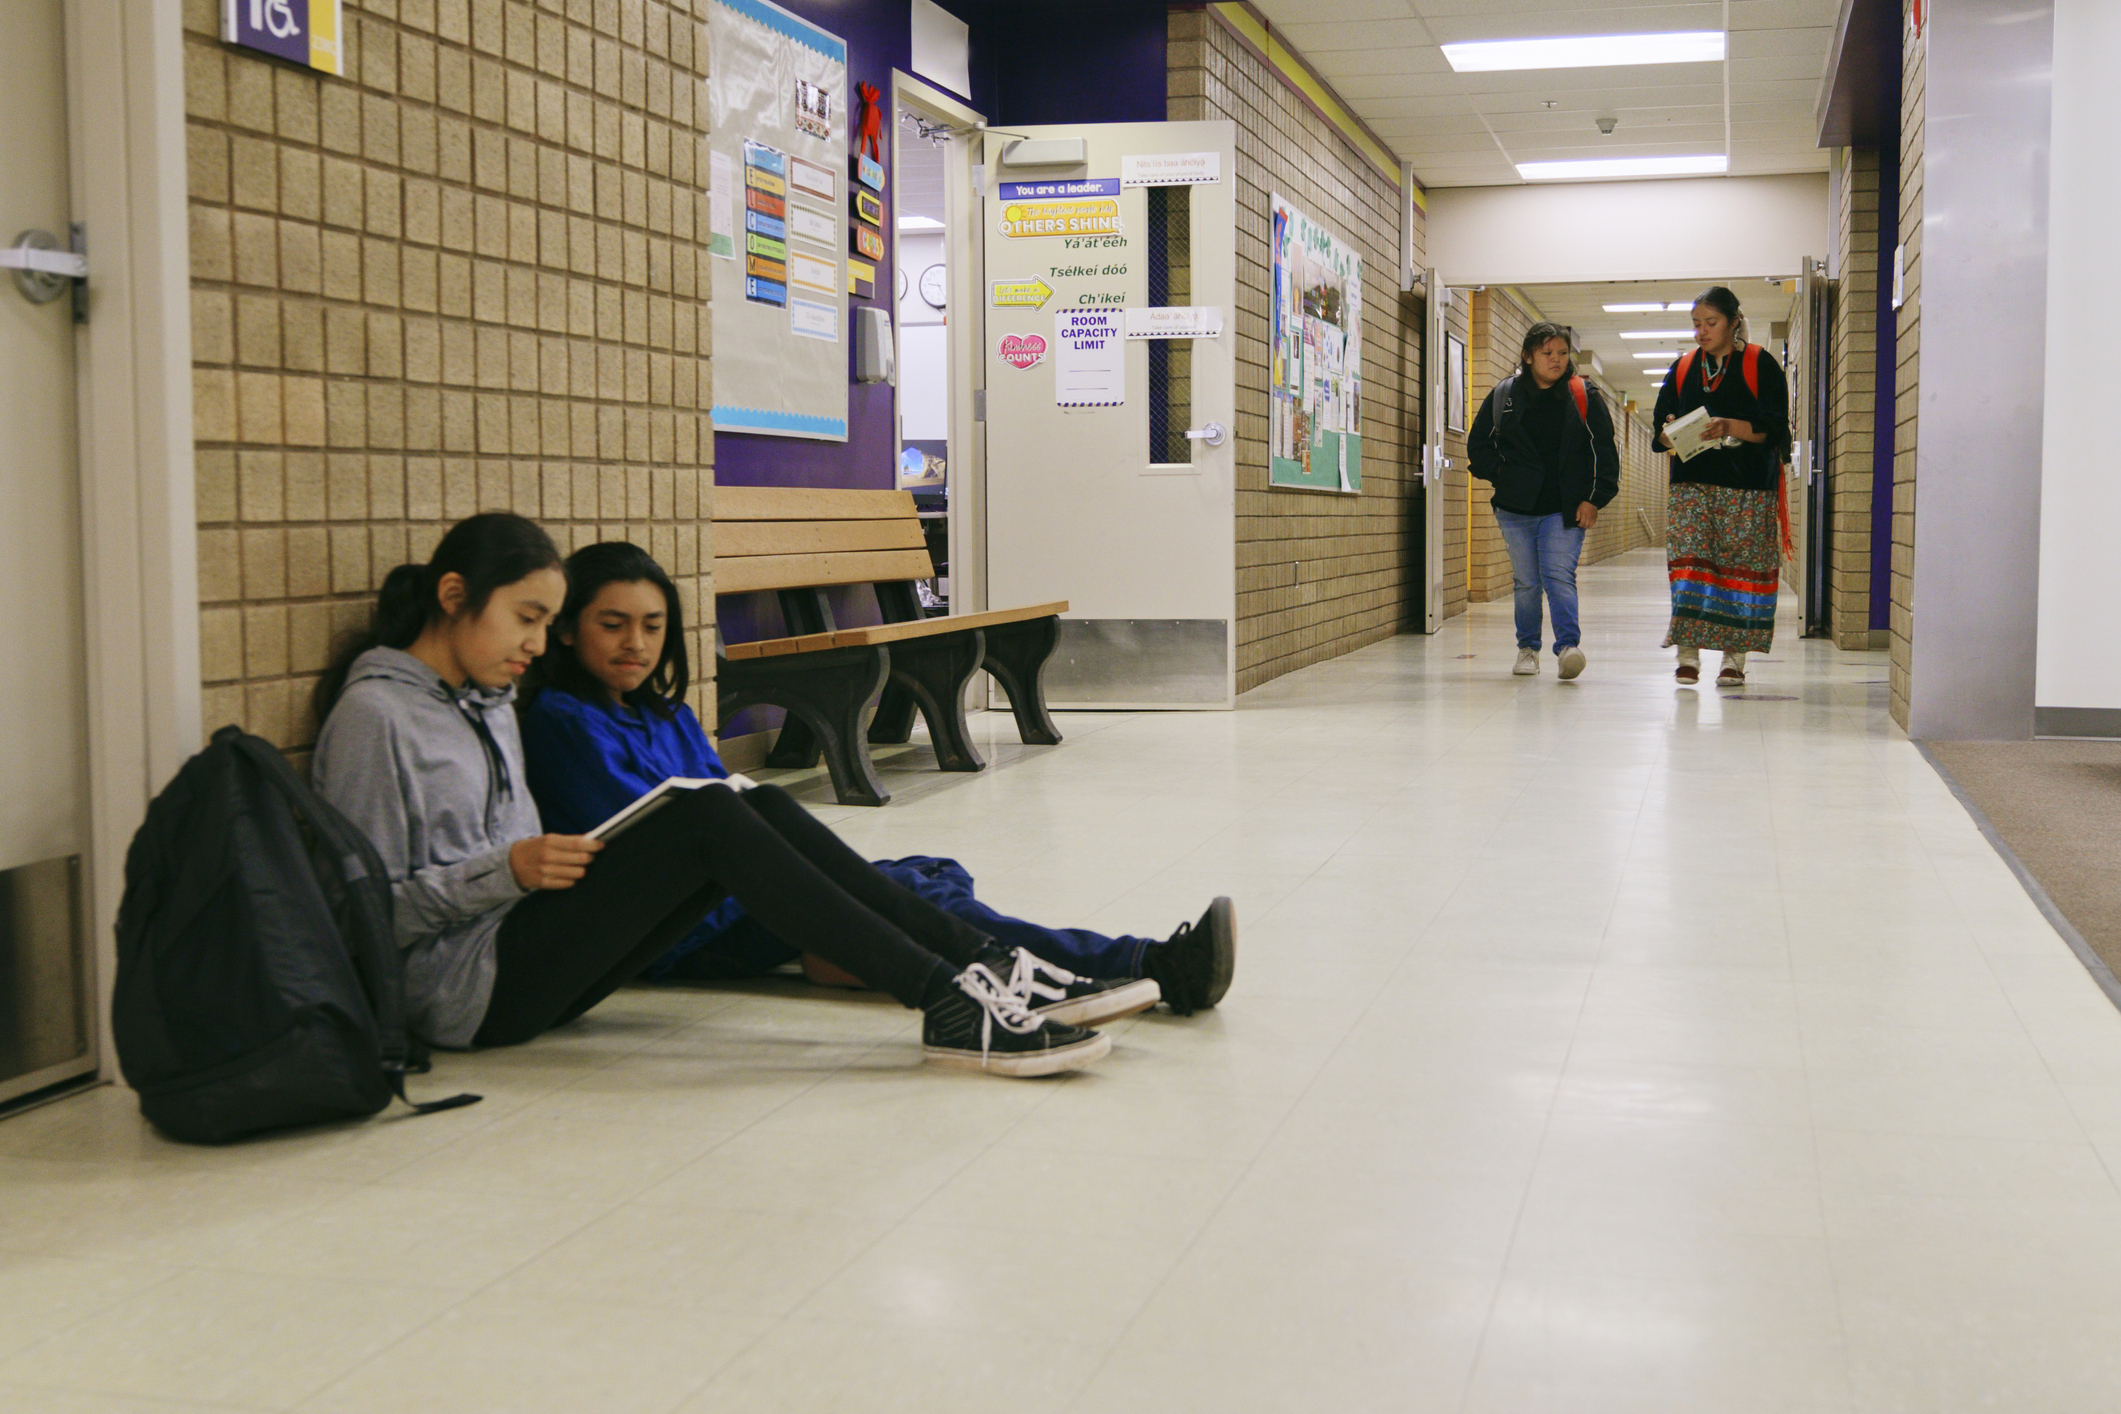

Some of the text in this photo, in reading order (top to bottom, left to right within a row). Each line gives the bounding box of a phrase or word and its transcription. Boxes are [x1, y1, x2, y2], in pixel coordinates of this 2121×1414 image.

[1016, 182, 1105, 196] You are a leader.
[1099, 203, 1115, 214] help
[1000, 218, 1066, 234] OTHERS
[1102, 262, 1127, 276] dóó
[993, 294, 1047, 303] DIFFERENCE
[1071, 316, 1107, 326] ROOM
[1061, 328, 1118, 338] CAPACITY
[1074, 340, 1105, 350] LIMIT
[998, 353, 1044, 363] COUNTS
